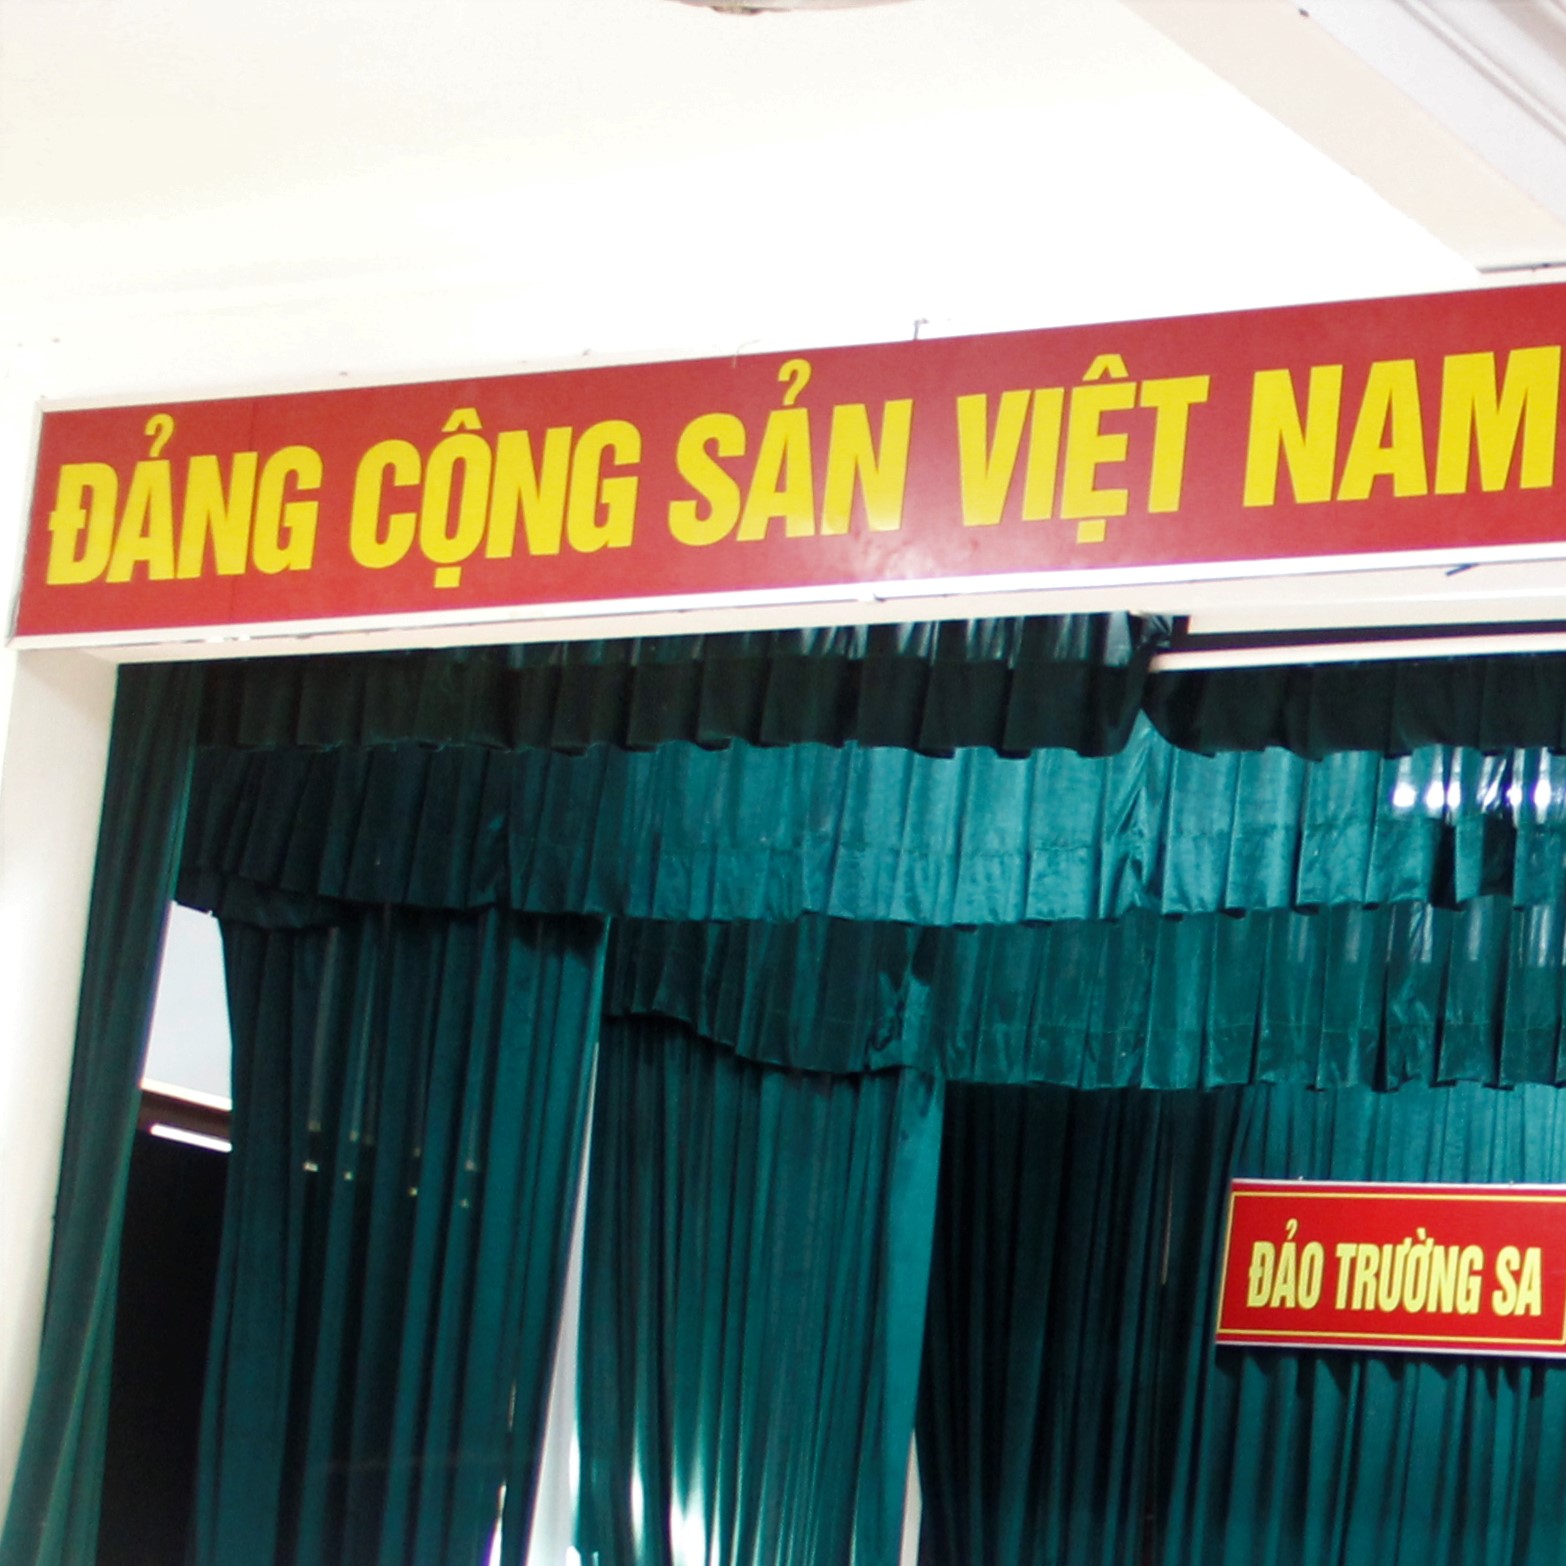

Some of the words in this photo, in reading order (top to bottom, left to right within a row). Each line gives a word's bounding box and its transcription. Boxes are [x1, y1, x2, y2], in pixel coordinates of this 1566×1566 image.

[45, 411, 324, 587] ĐẢNG
[349, 406, 643, 589] CỘNG
[667, 357, 915, 548] SẢN
[955, 353, 1211, 544] VIỆT
[1242, 345, 1562, 508] NAM
[1247, 1218, 1325, 1310] ĐẢO
[1335, 1227, 1485, 1315] TRƯỜNG
[1491, 1245, 1542, 1317] SA
